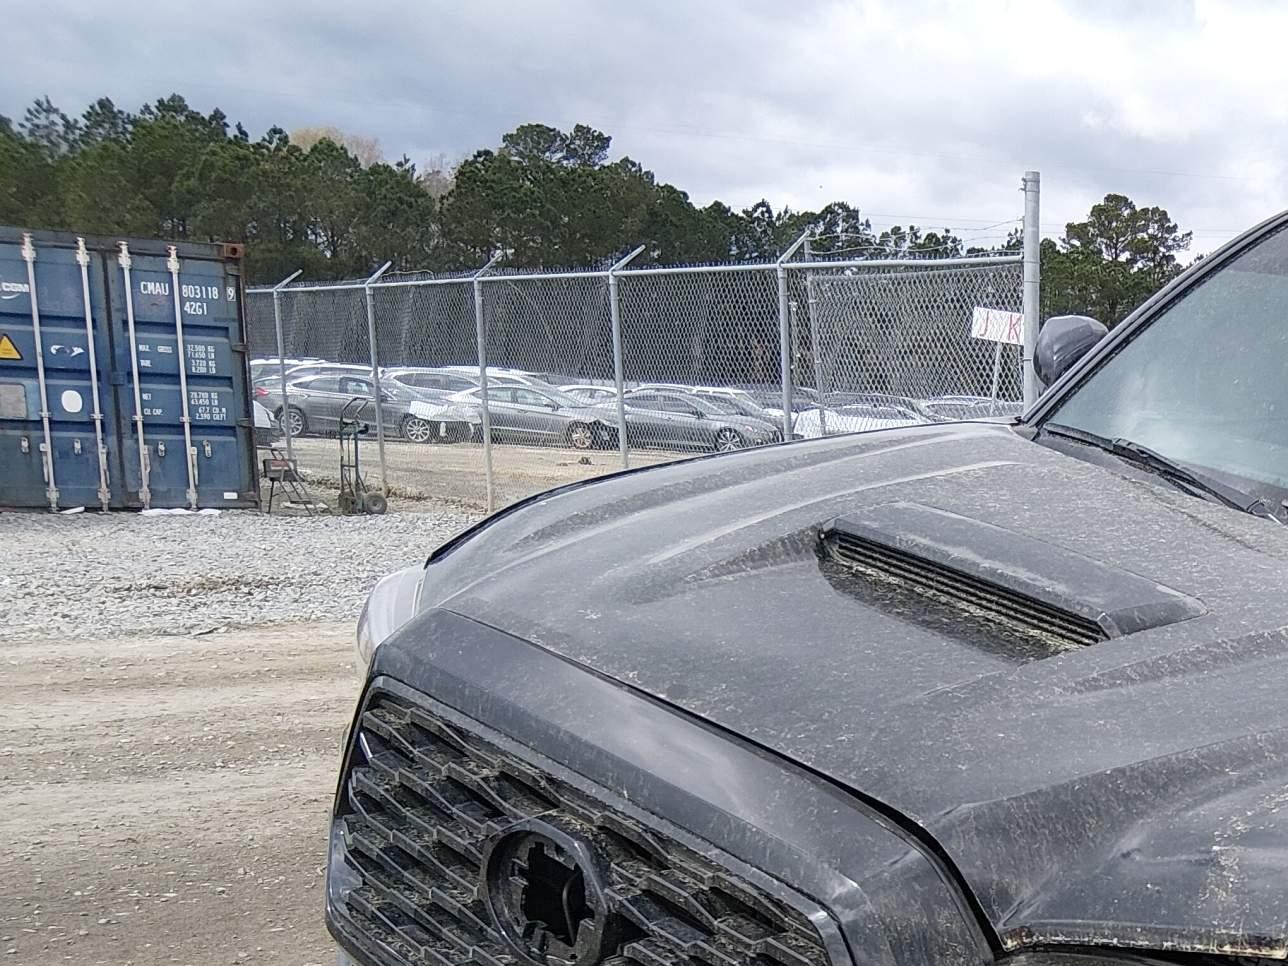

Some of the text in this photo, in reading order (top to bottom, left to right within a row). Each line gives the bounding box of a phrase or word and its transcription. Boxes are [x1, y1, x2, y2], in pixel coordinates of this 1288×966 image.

[140, 281, 170, 296] CMAU
[182, 285, 219, 299] 803118
[184, 301, 208, 315] 42G1
